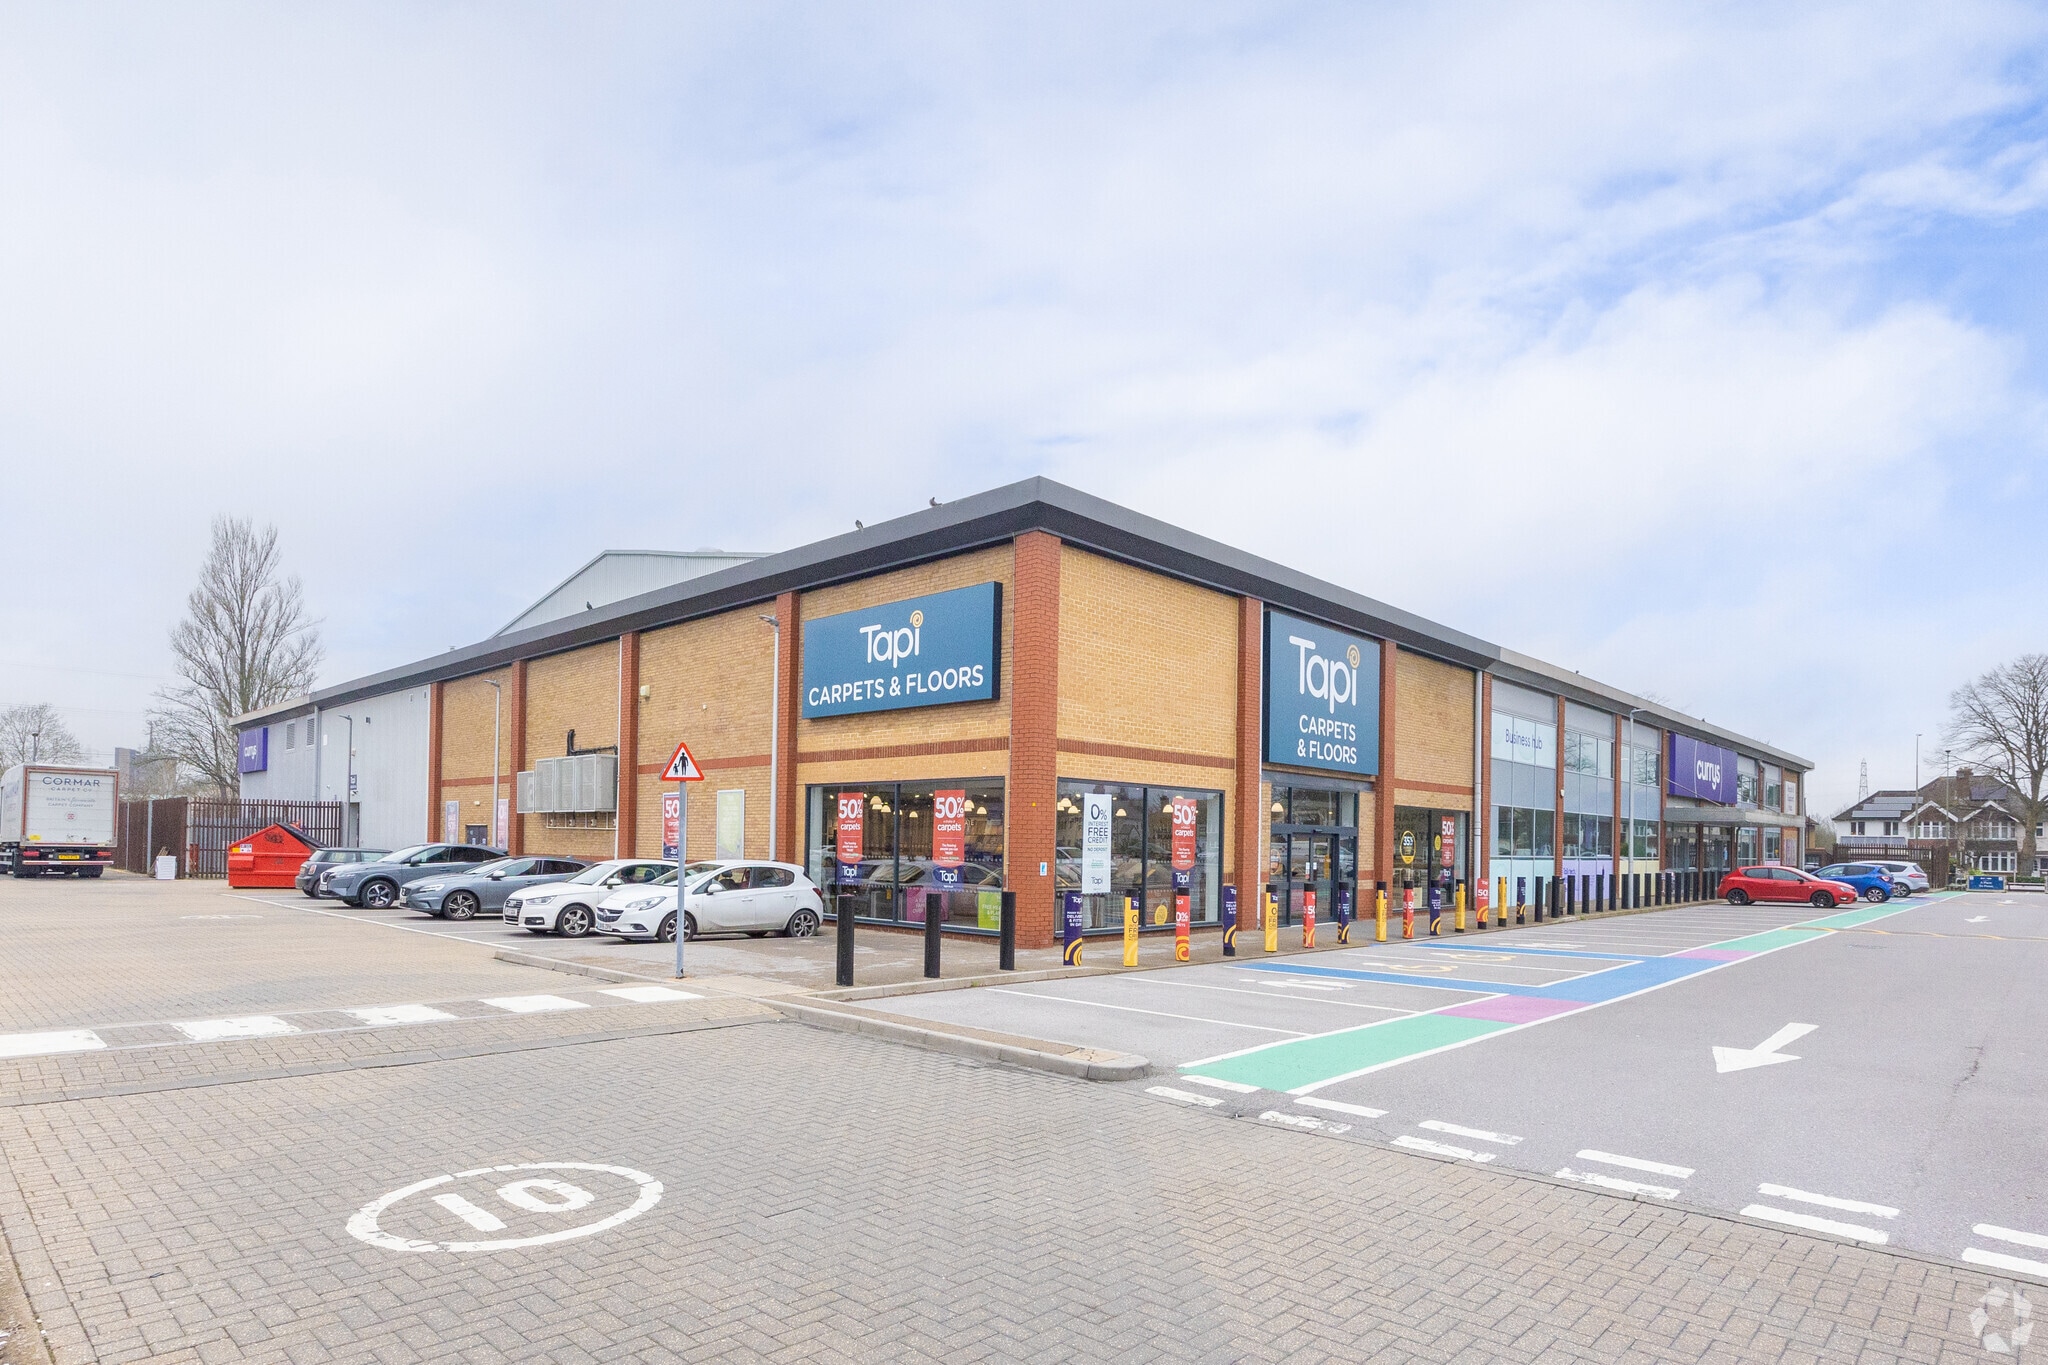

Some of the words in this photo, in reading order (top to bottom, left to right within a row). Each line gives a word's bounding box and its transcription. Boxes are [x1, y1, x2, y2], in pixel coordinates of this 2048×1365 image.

[859, 609, 924, 669] Tapi
[808, 678, 885, 706] CARPETS
[889, 676, 901, 697] &
[906, 664, 984, 695] FLOORS
[1289, 635, 1361, 714] Tapi
[1299, 714, 1356, 742] CARPETS
[1505, 729, 1531, 748] Business
[1532, 734, 1542, 750] hub
[1297, 738, 1306, 758] &
[1309, 740, 1357, 765] FLOORS
[42, 776, 100, 787] CORMAR
[1696, 759, 1721, 790] currys
[838, 798, 864, 819] 50%
[934, 796, 965, 819] 50%
[1090, 803, 1108, 820] 0%
[1173, 804, 1197, 825] 50%
[840, 822, 861, 832] carpets
[937, 823, 962, 833] carpets
[1088, 827, 1108, 836] FREE
[1174, 828, 1194, 838] carpets
[1087, 836, 1108, 844] CREDIT
[842, 865, 857, 878] Tapi
[940, 869, 958, 884] Tapi
[1175, 871, 1190, 885] Tapi
[431, 1178, 596, 1233] 10
